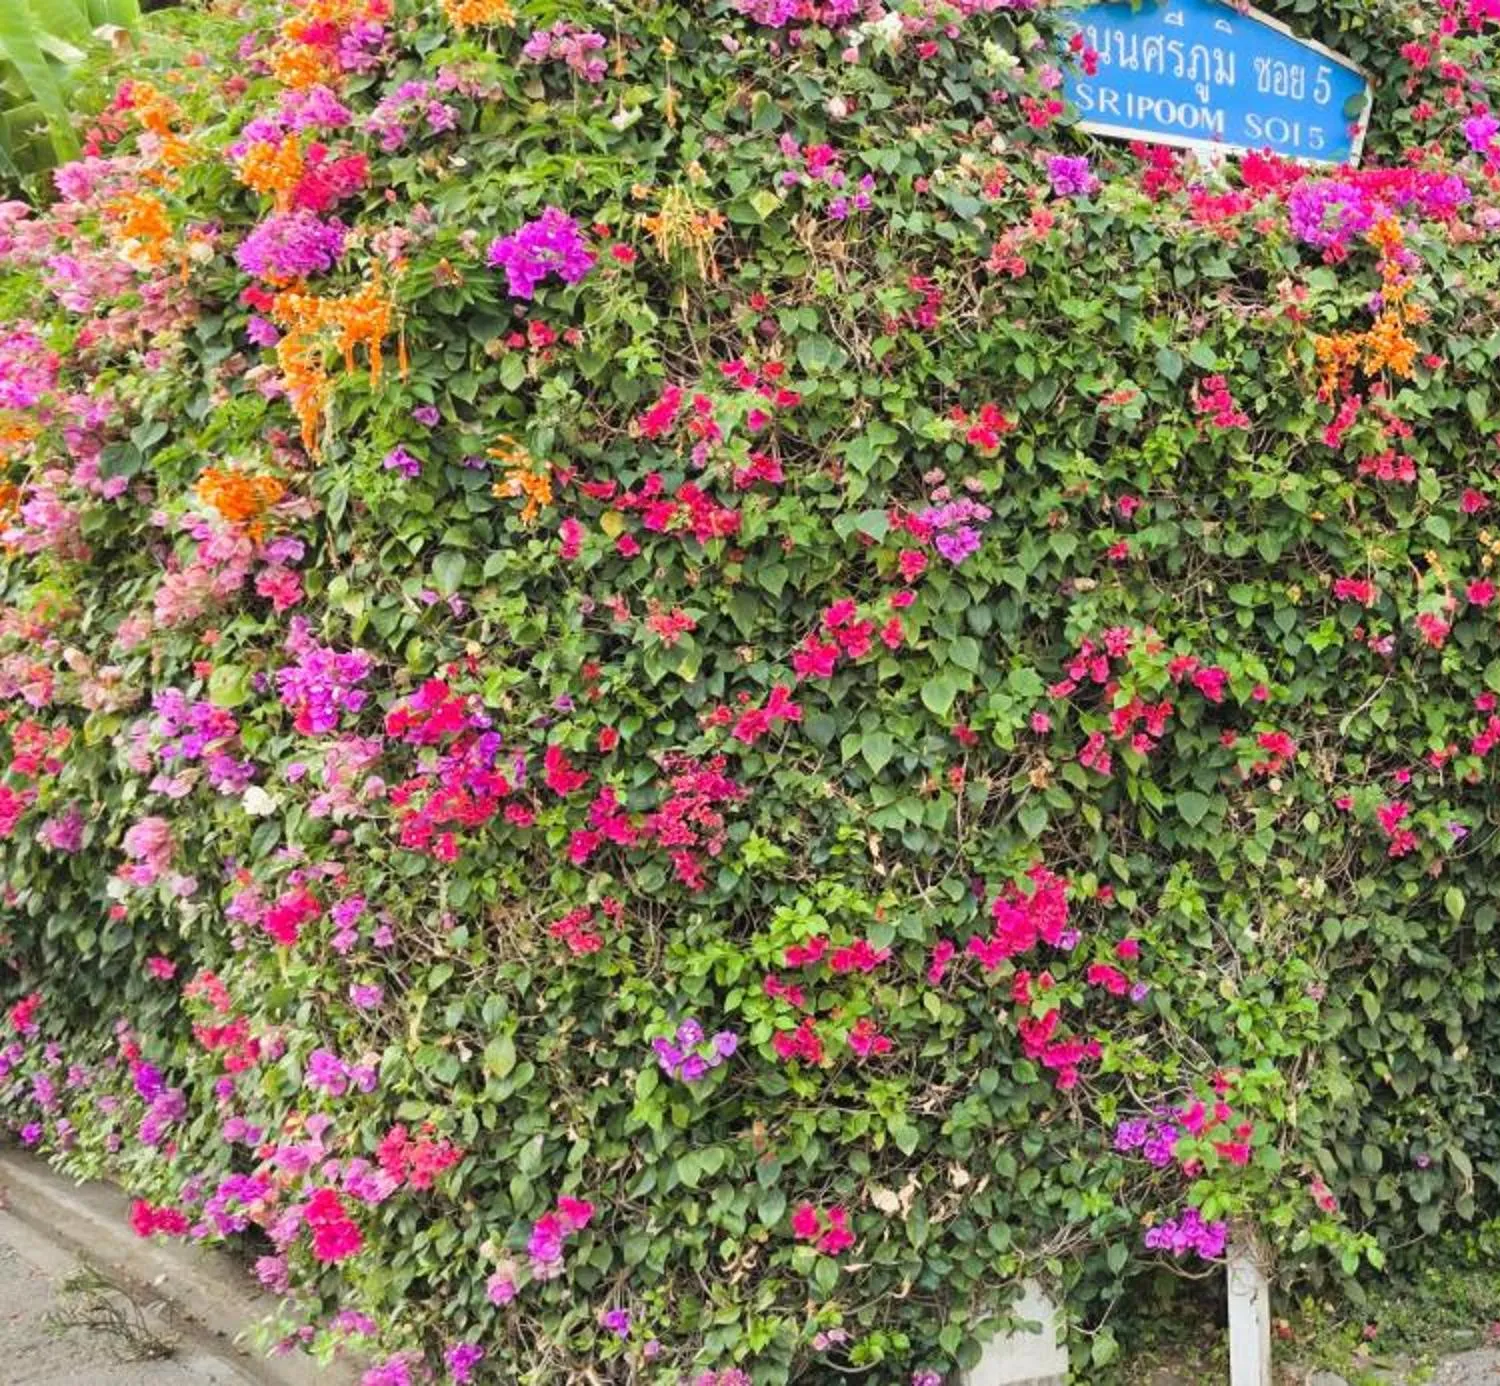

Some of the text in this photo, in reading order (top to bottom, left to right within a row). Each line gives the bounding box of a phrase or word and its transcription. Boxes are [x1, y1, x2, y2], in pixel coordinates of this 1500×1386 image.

[1253, 56, 1305, 99] ซอย
[1313, 65, 1331, 105] 5
[1075, 83, 1325, 150] SRIPOOM SOI 5
